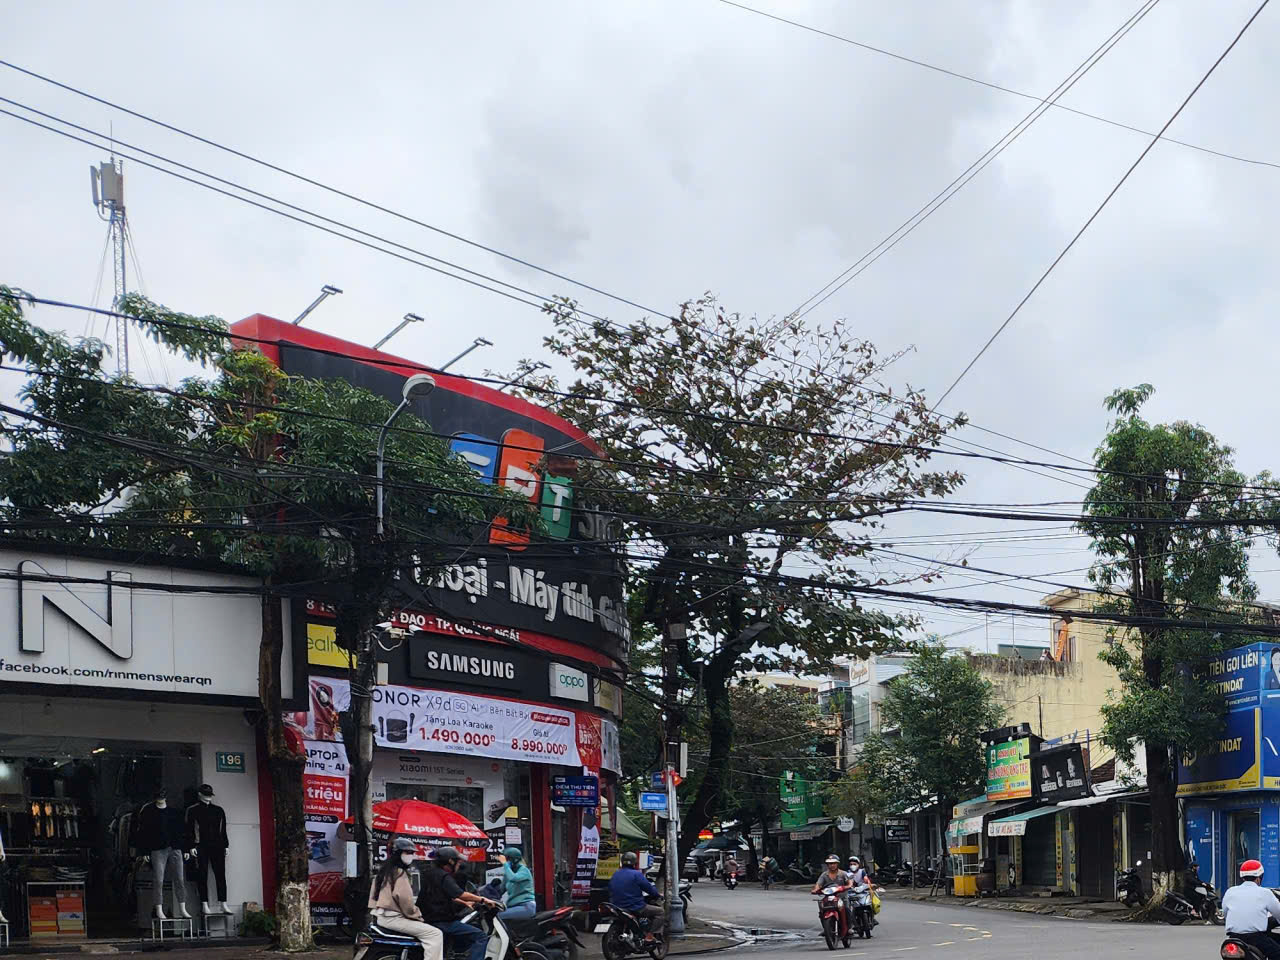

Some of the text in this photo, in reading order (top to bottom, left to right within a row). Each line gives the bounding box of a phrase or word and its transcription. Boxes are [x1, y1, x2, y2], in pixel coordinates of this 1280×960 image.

[508, 565, 560, 622] Máy
[427, 650, 515, 680] SAMSUNG
[1241, 648, 1259, 669] LIỀN
[0, 659, 212, 686] facebook.com/rinmenswearqn
[371, 688, 420, 708] ONOR
[447, 716, 461, 726] Loa
[462, 718, 494, 731] Karaoke
[220, 754, 241, 765] 196
[306, 786, 343, 804] triệu
[404, 823, 445, 835] Laptop
[374, 845, 388, 862] .5
